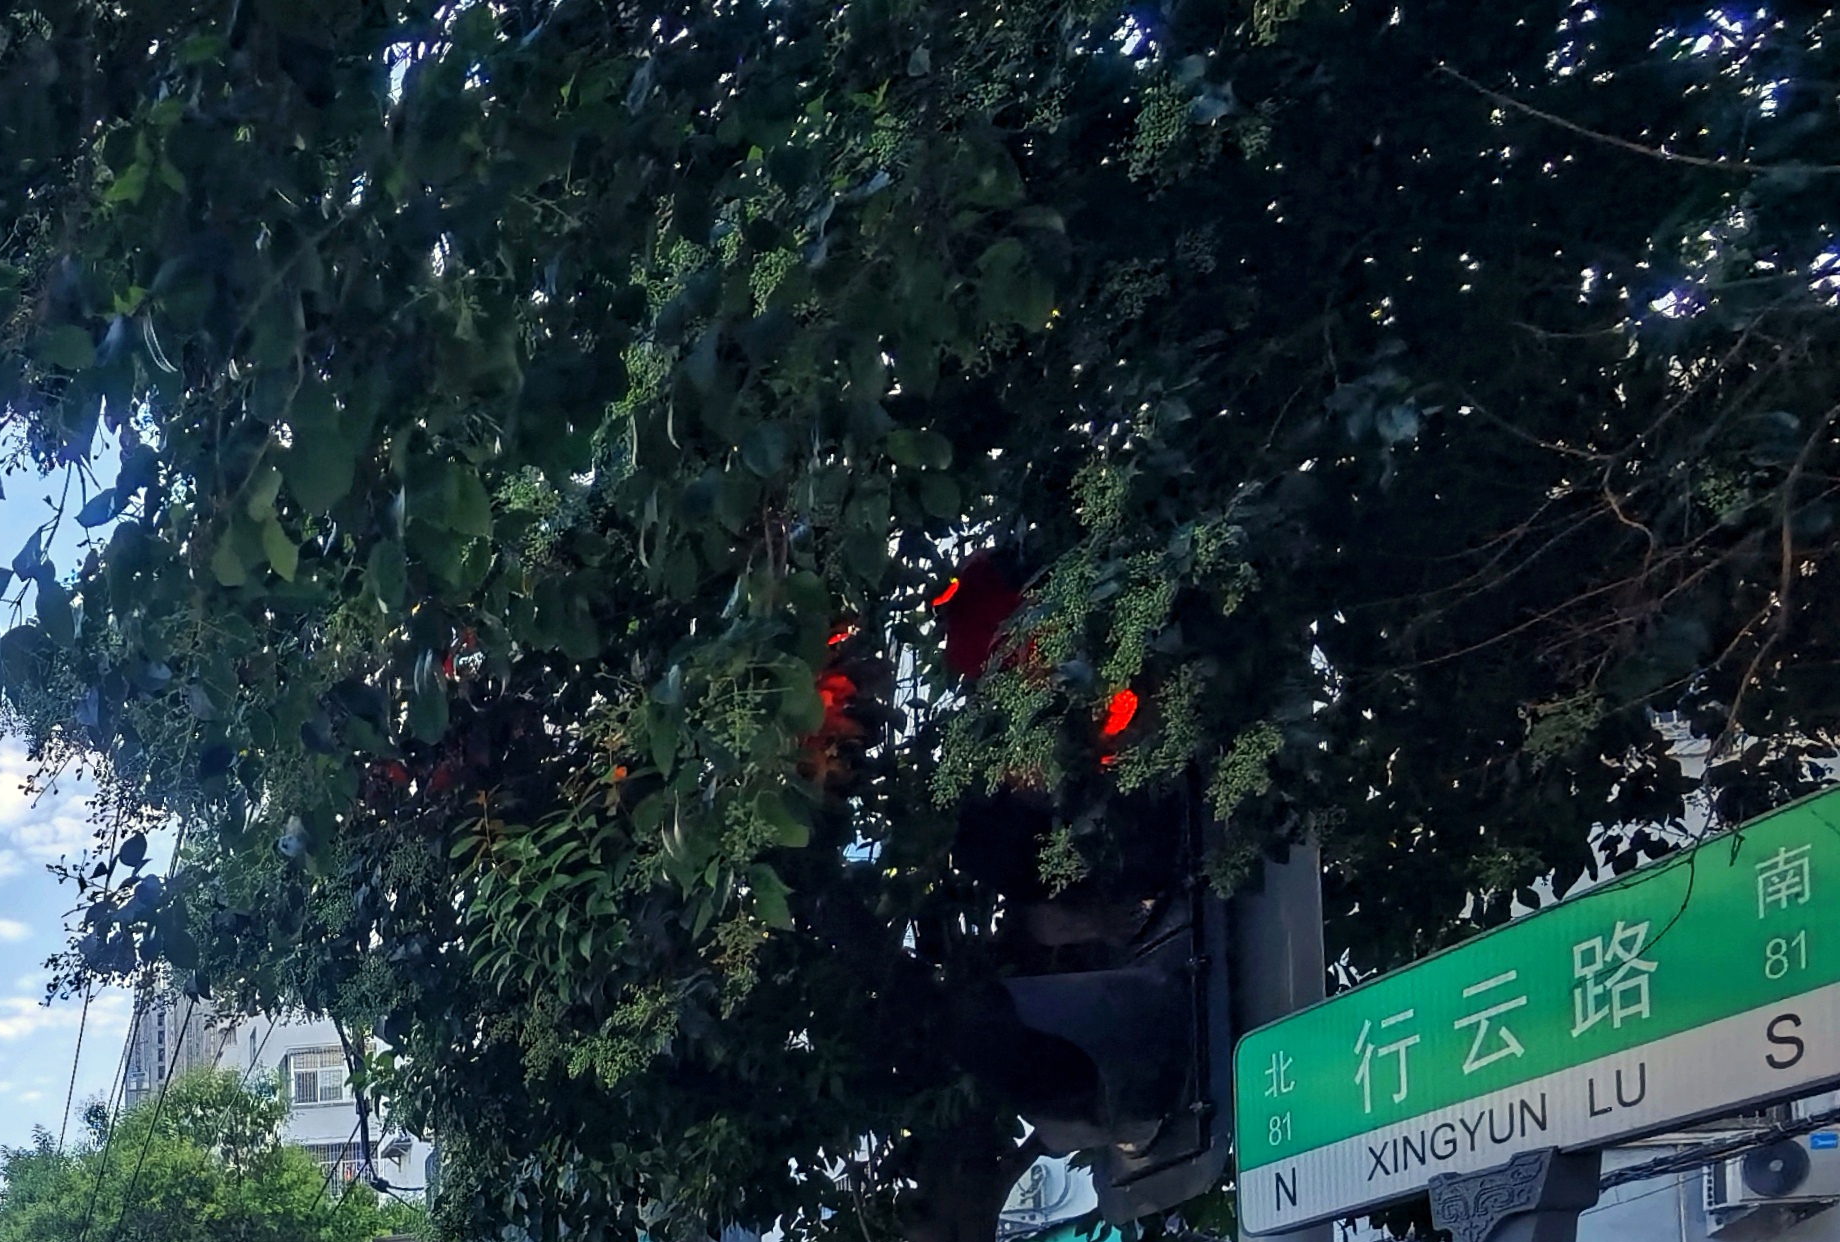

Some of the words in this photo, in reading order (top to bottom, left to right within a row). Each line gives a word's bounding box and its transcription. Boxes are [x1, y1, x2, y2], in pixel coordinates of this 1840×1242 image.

[1754, 842, 1813, 920] 南
[1763, 930, 1808, 980] 81
[1353, 920, 1659, 1115] 行云路
[1764, 1012, 1806, 1070] S
[1263, 1049, 1297, 1100] 北
[1267, 1110, 1293, 1147] 81
[1366, 1092, 1549, 1181] XINGYUN
[1587, 1061, 1648, 1119] LU
[1274, 1166, 1299, 1212] N
